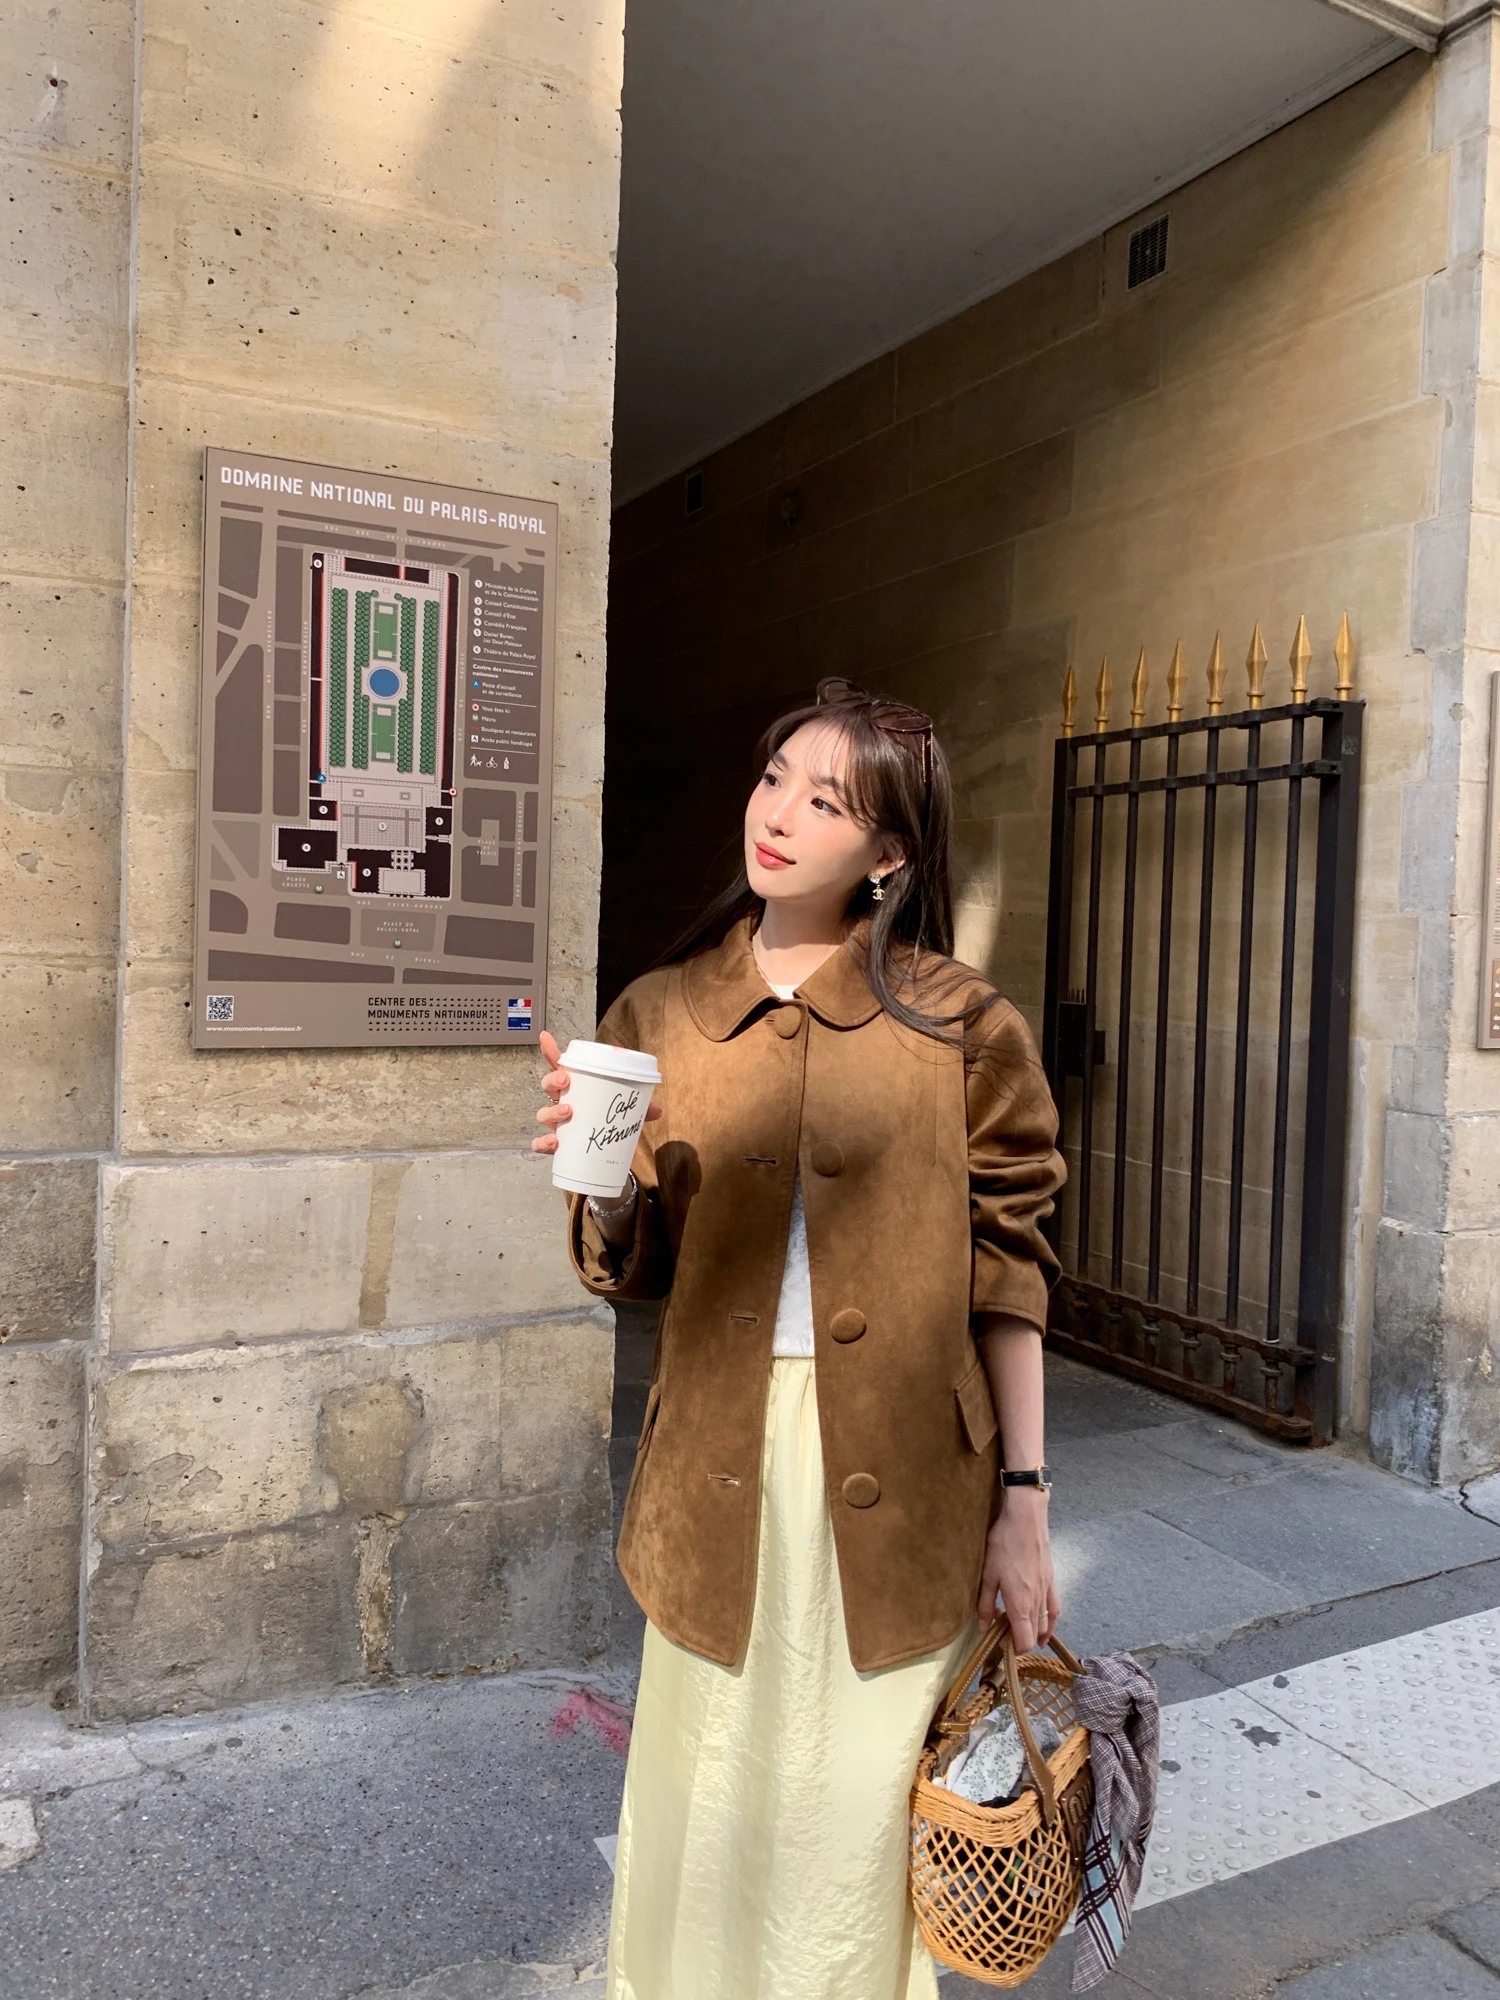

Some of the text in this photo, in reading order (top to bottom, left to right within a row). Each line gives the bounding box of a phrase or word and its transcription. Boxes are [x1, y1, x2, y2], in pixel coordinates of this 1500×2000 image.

[221, 467, 547, 535] DOMAINE NATIONAL DU PALAIS-ROYAL
[520, 587, 537, 595] Culture
[503, 592, 539, 601] Communication
[484, 599, 502, 607] Conseil
[484, 610, 502, 618] Conseil
[472, 671, 499, 679] nationaux
[503, 669, 534, 677] monuments
[481, 726, 504, 734] Boutiques
[368, 997, 427, 1006] CENTRE DES
[367, 1009, 488, 1019] MONUMENTS NATIONAUX
[605, 1090, 641, 1124] Café
